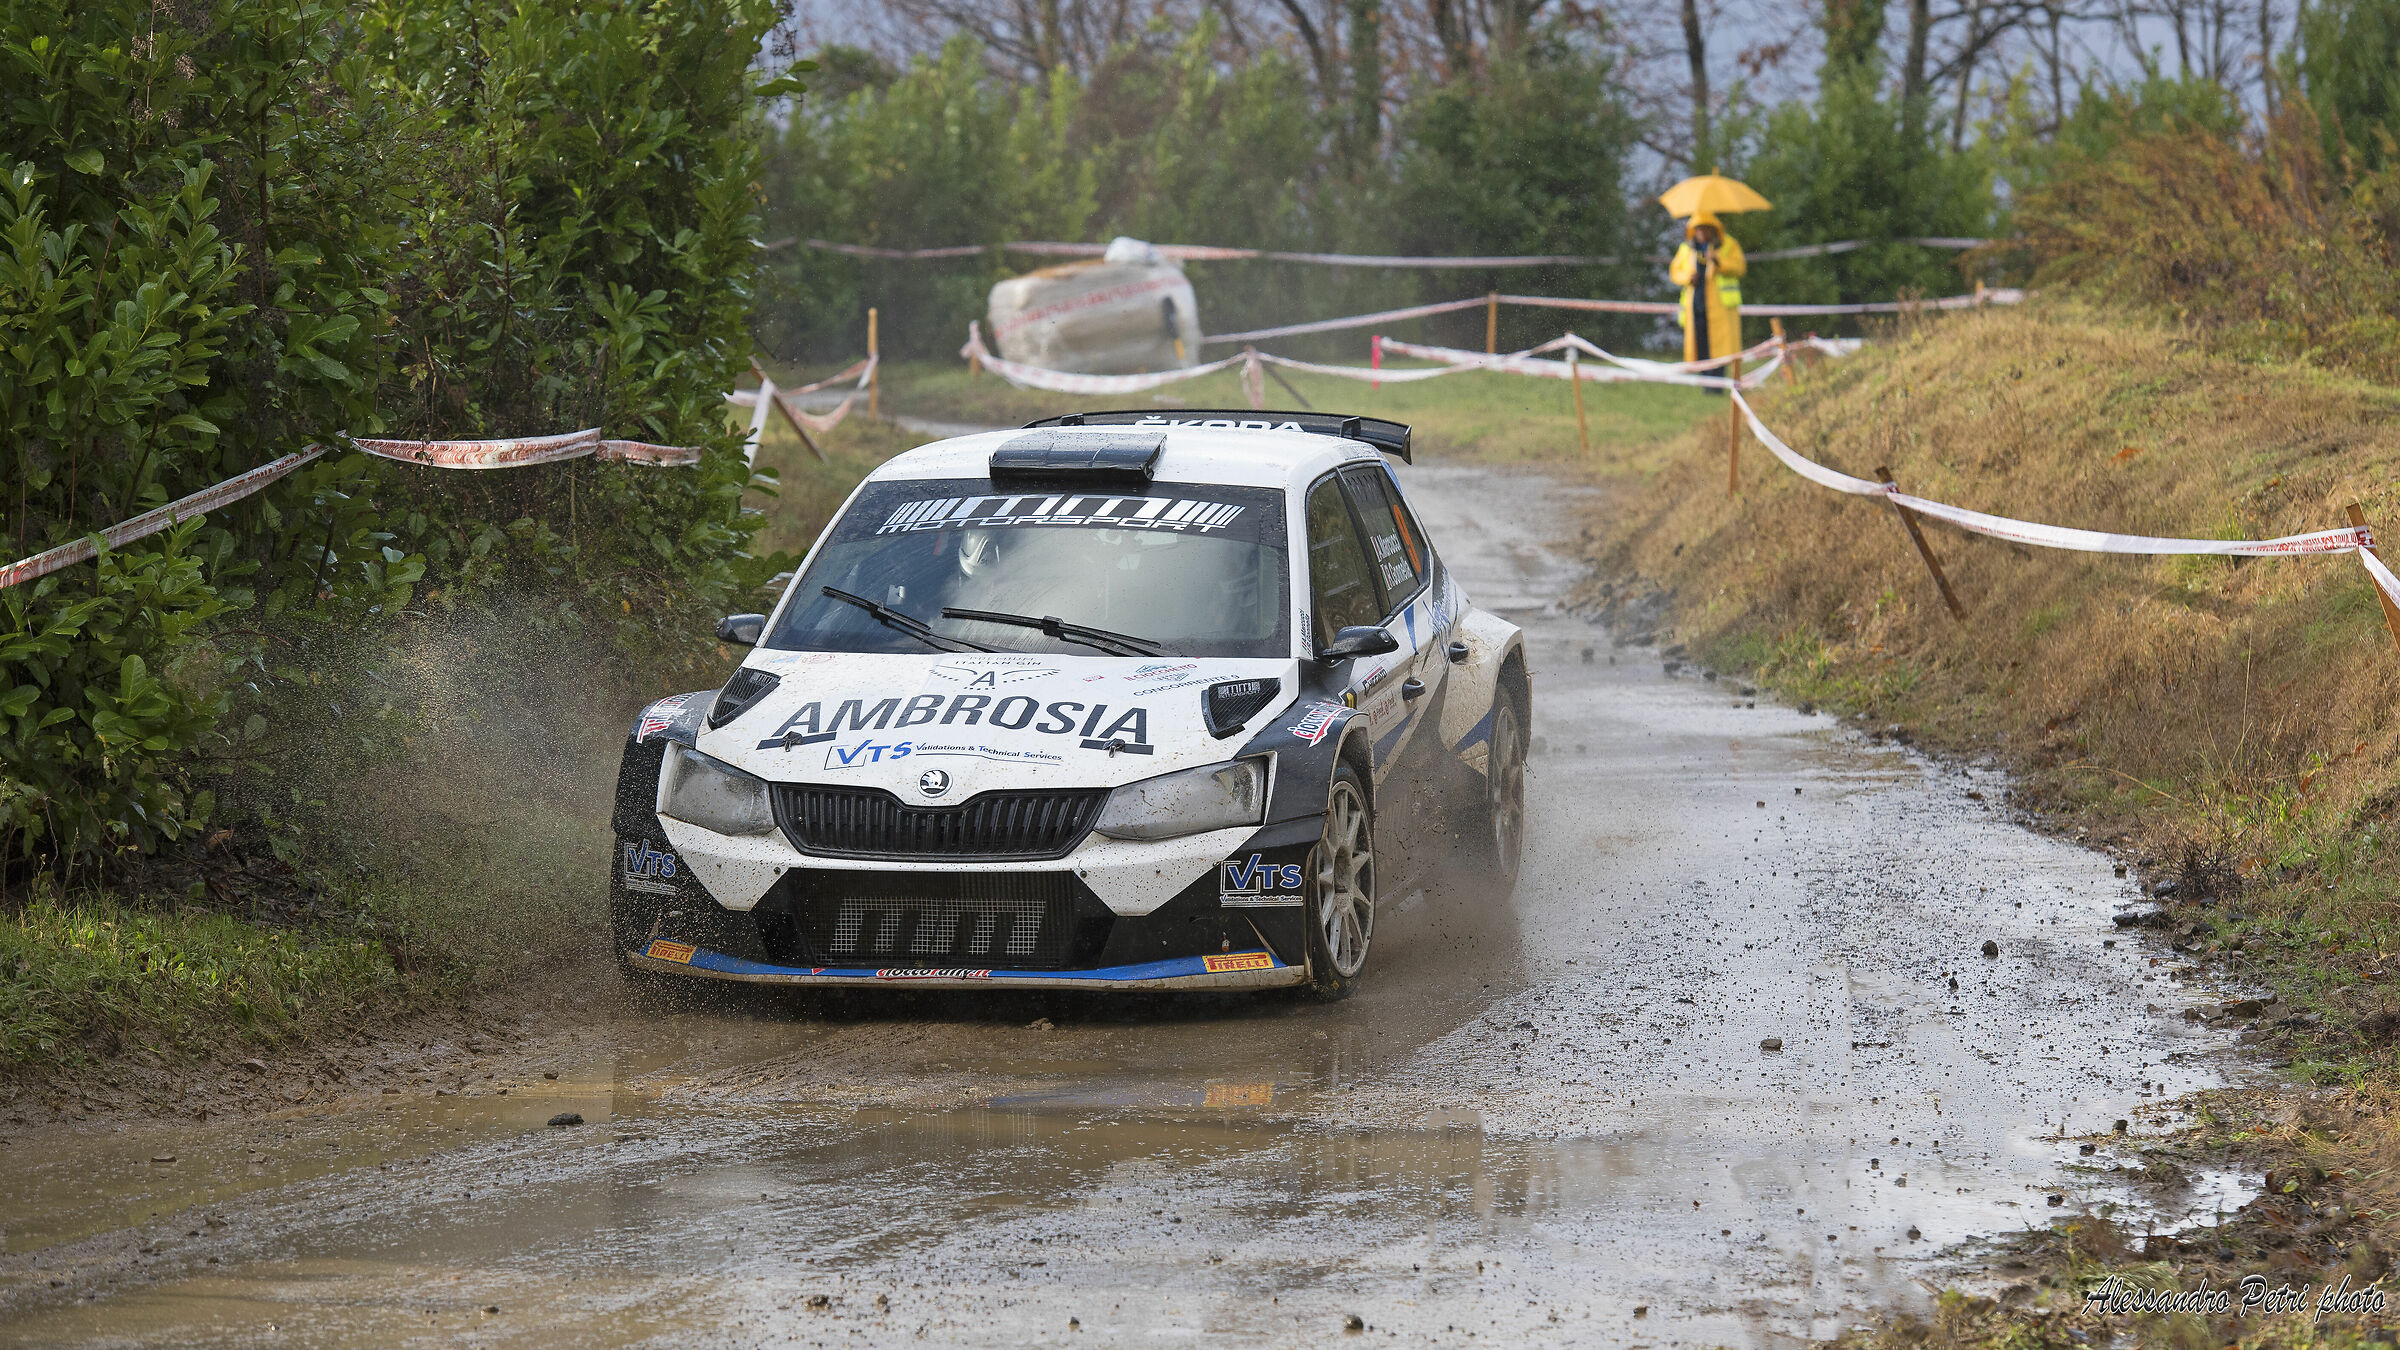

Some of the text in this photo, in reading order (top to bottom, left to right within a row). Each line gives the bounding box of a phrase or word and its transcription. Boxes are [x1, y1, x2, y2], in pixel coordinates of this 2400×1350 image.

[876, 515, 1226, 534] MOTORSPORT
[969, 670, 996, 686] A
[1133, 675, 1228, 696] CONCORRENTE
[772, 694, 1149, 745] AMBROSIA
[836, 739, 913, 765] VTS
[916, 742, 966, 751] Validations
[979, 745, 1020, 758] Technical
[1024, 751, 1062, 760] Services
[629, 839, 676, 878] VTS
[1227, 853, 1303, 890] VTS
[650, 941, 693, 961] PIRELLI
[1207, 954, 1269, 970] PIRELLI
